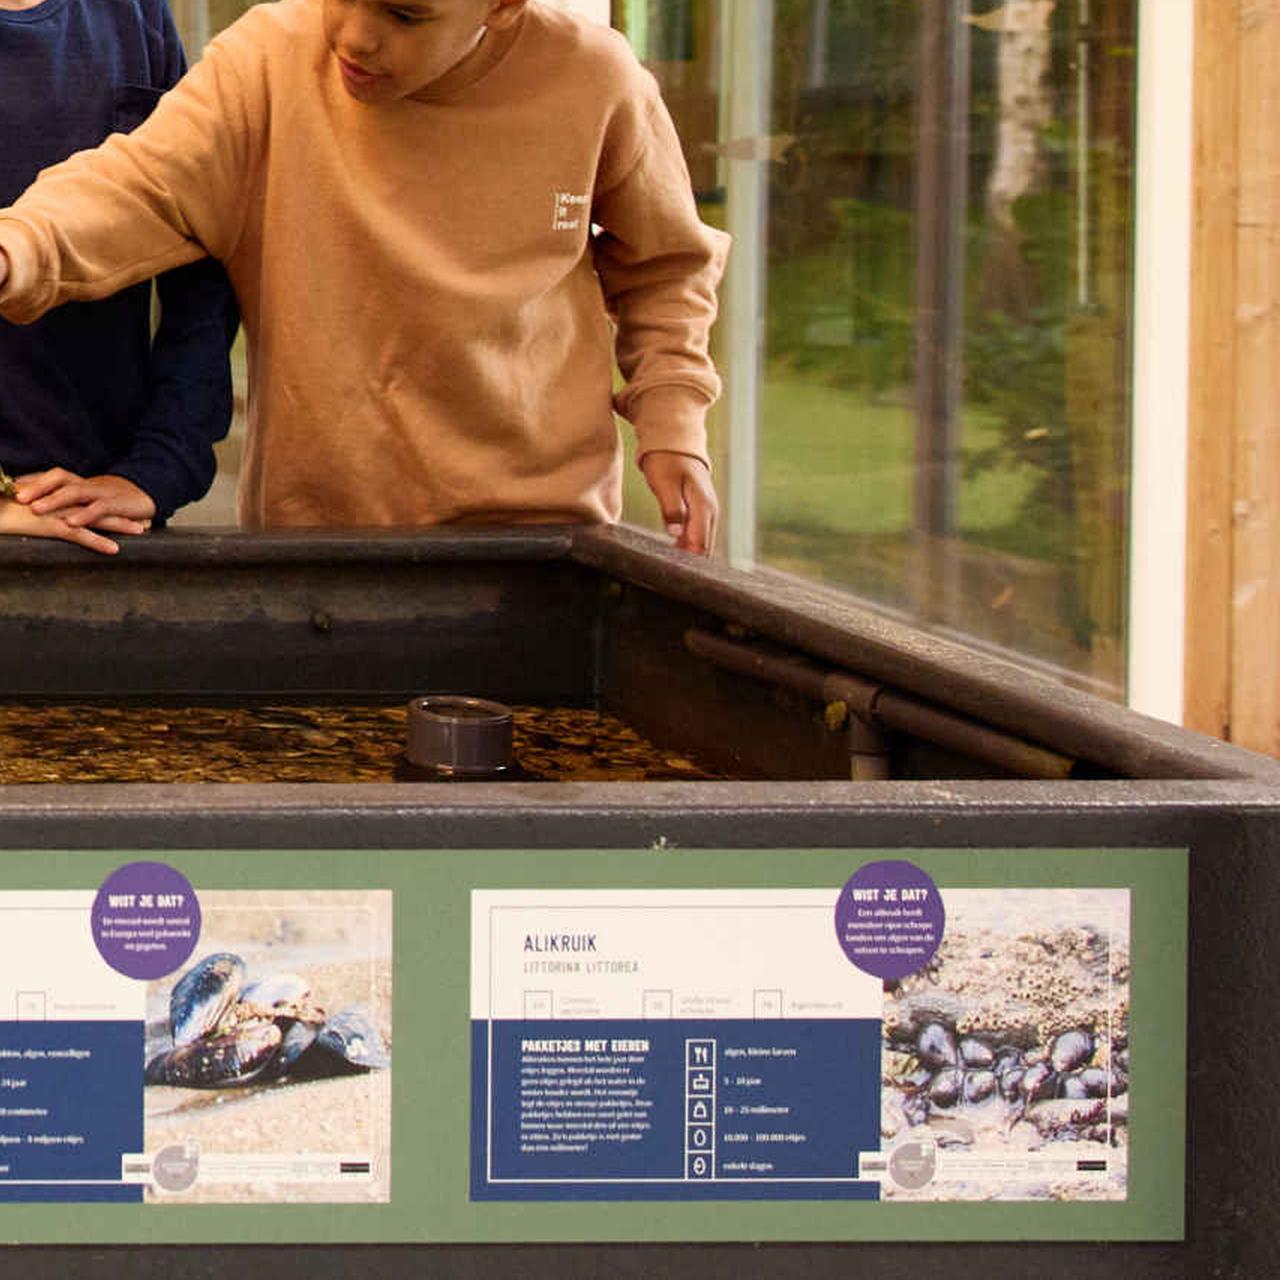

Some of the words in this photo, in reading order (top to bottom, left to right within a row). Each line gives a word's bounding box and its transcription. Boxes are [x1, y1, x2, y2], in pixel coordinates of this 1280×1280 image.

[108, 895, 136, 908] WIST
[140, 895, 154, 908] JE
[853, 889, 880, 902] WIST
[883, 889, 898, 902] JE
[901, 889, 928, 901] DAT?
[524, 935, 598, 952] ALIKRUIK
[521, 1039, 582, 1053] PAKKETJES
[584, 1039, 609, 1053] MET
[611, 1039, 650, 1053] EIEREN
